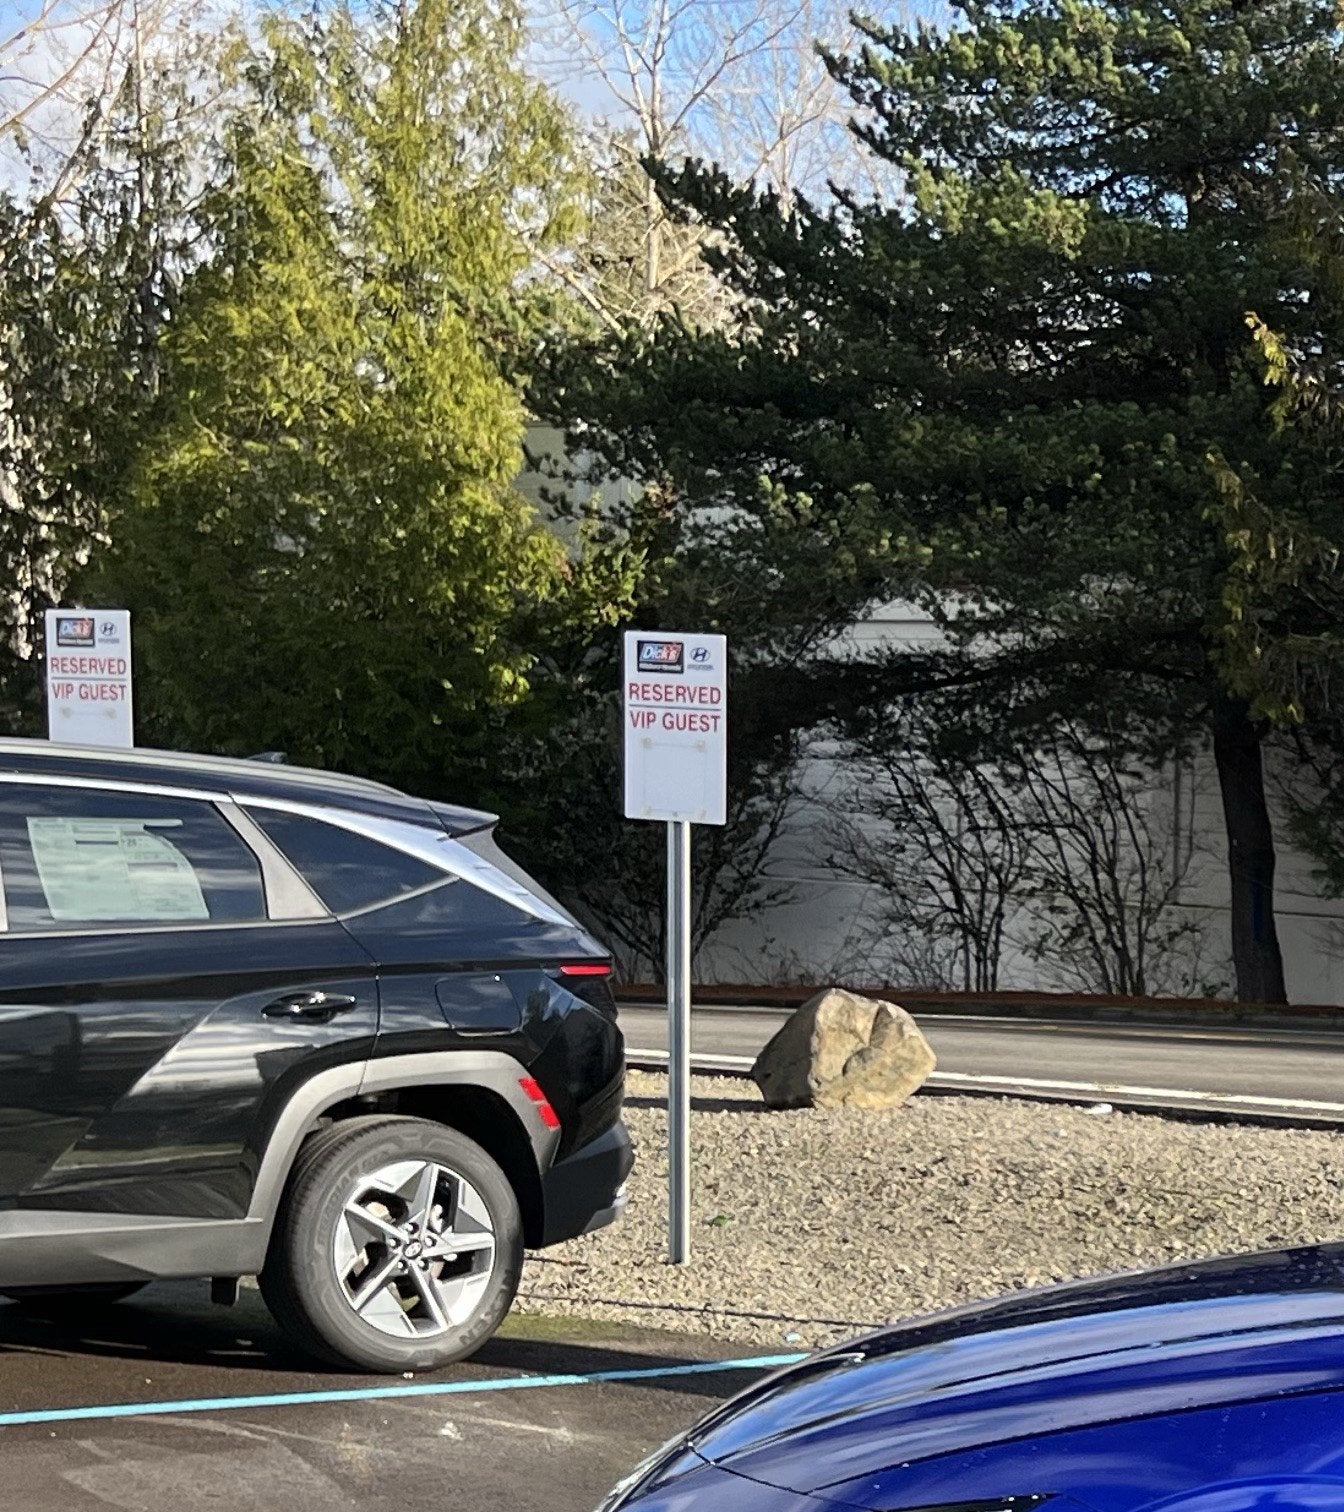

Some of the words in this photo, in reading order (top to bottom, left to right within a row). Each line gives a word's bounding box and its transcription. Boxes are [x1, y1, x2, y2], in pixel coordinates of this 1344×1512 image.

[50, 656, 127, 675] RESERVED
[51, 682, 74, 700] VIP
[79, 683, 127, 701] GUEST
[628, 682, 721, 705] RESERVED
[629, 710, 656, 729] VIP
[662, 711, 721, 733] GUEST
